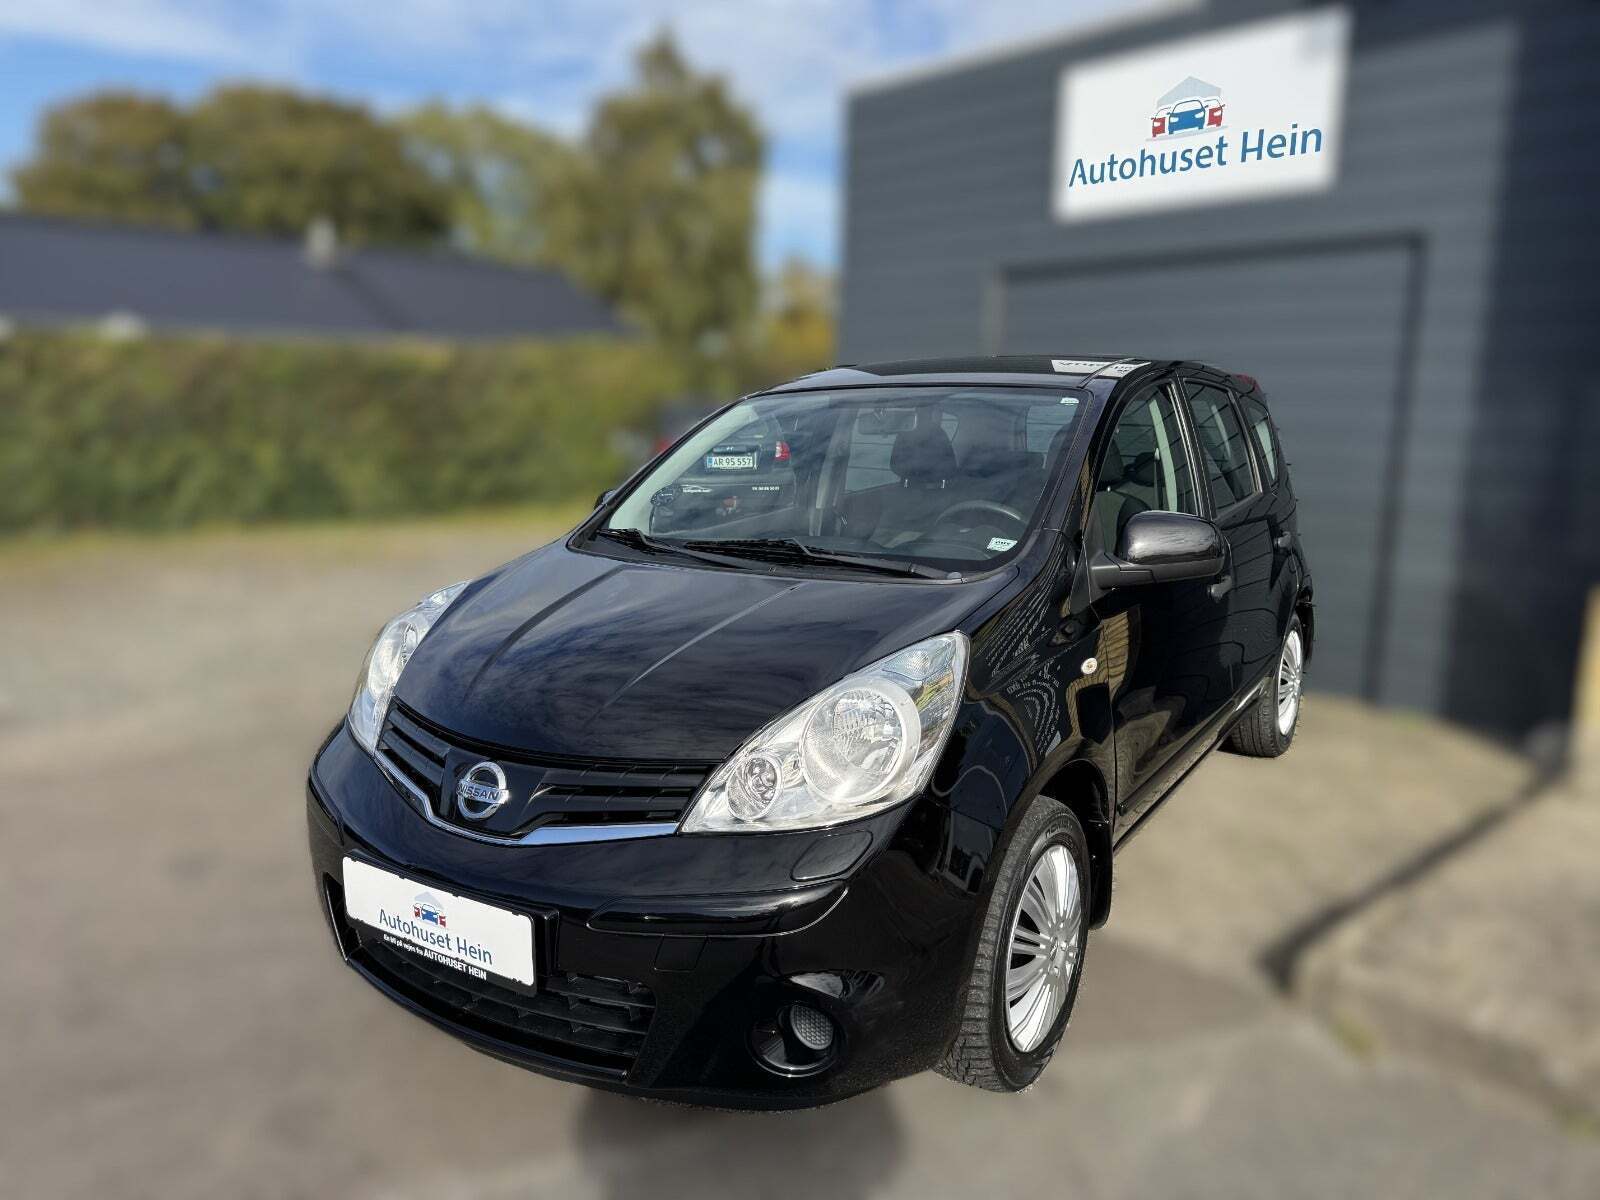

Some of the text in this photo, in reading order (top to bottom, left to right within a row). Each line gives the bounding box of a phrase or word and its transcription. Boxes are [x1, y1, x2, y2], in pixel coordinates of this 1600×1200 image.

[1068, 123, 1323, 187] Autohuset Hein
[713, 457, 724, 466] AR
[726, 457, 735, 466] 95
[459, 782, 500, 801] NISSAN
[379, 908, 493, 965] Autohuset Hein
[423, 949, 468, 973] AUTOHUSET
[468, 965, 487, 981] HEIN
